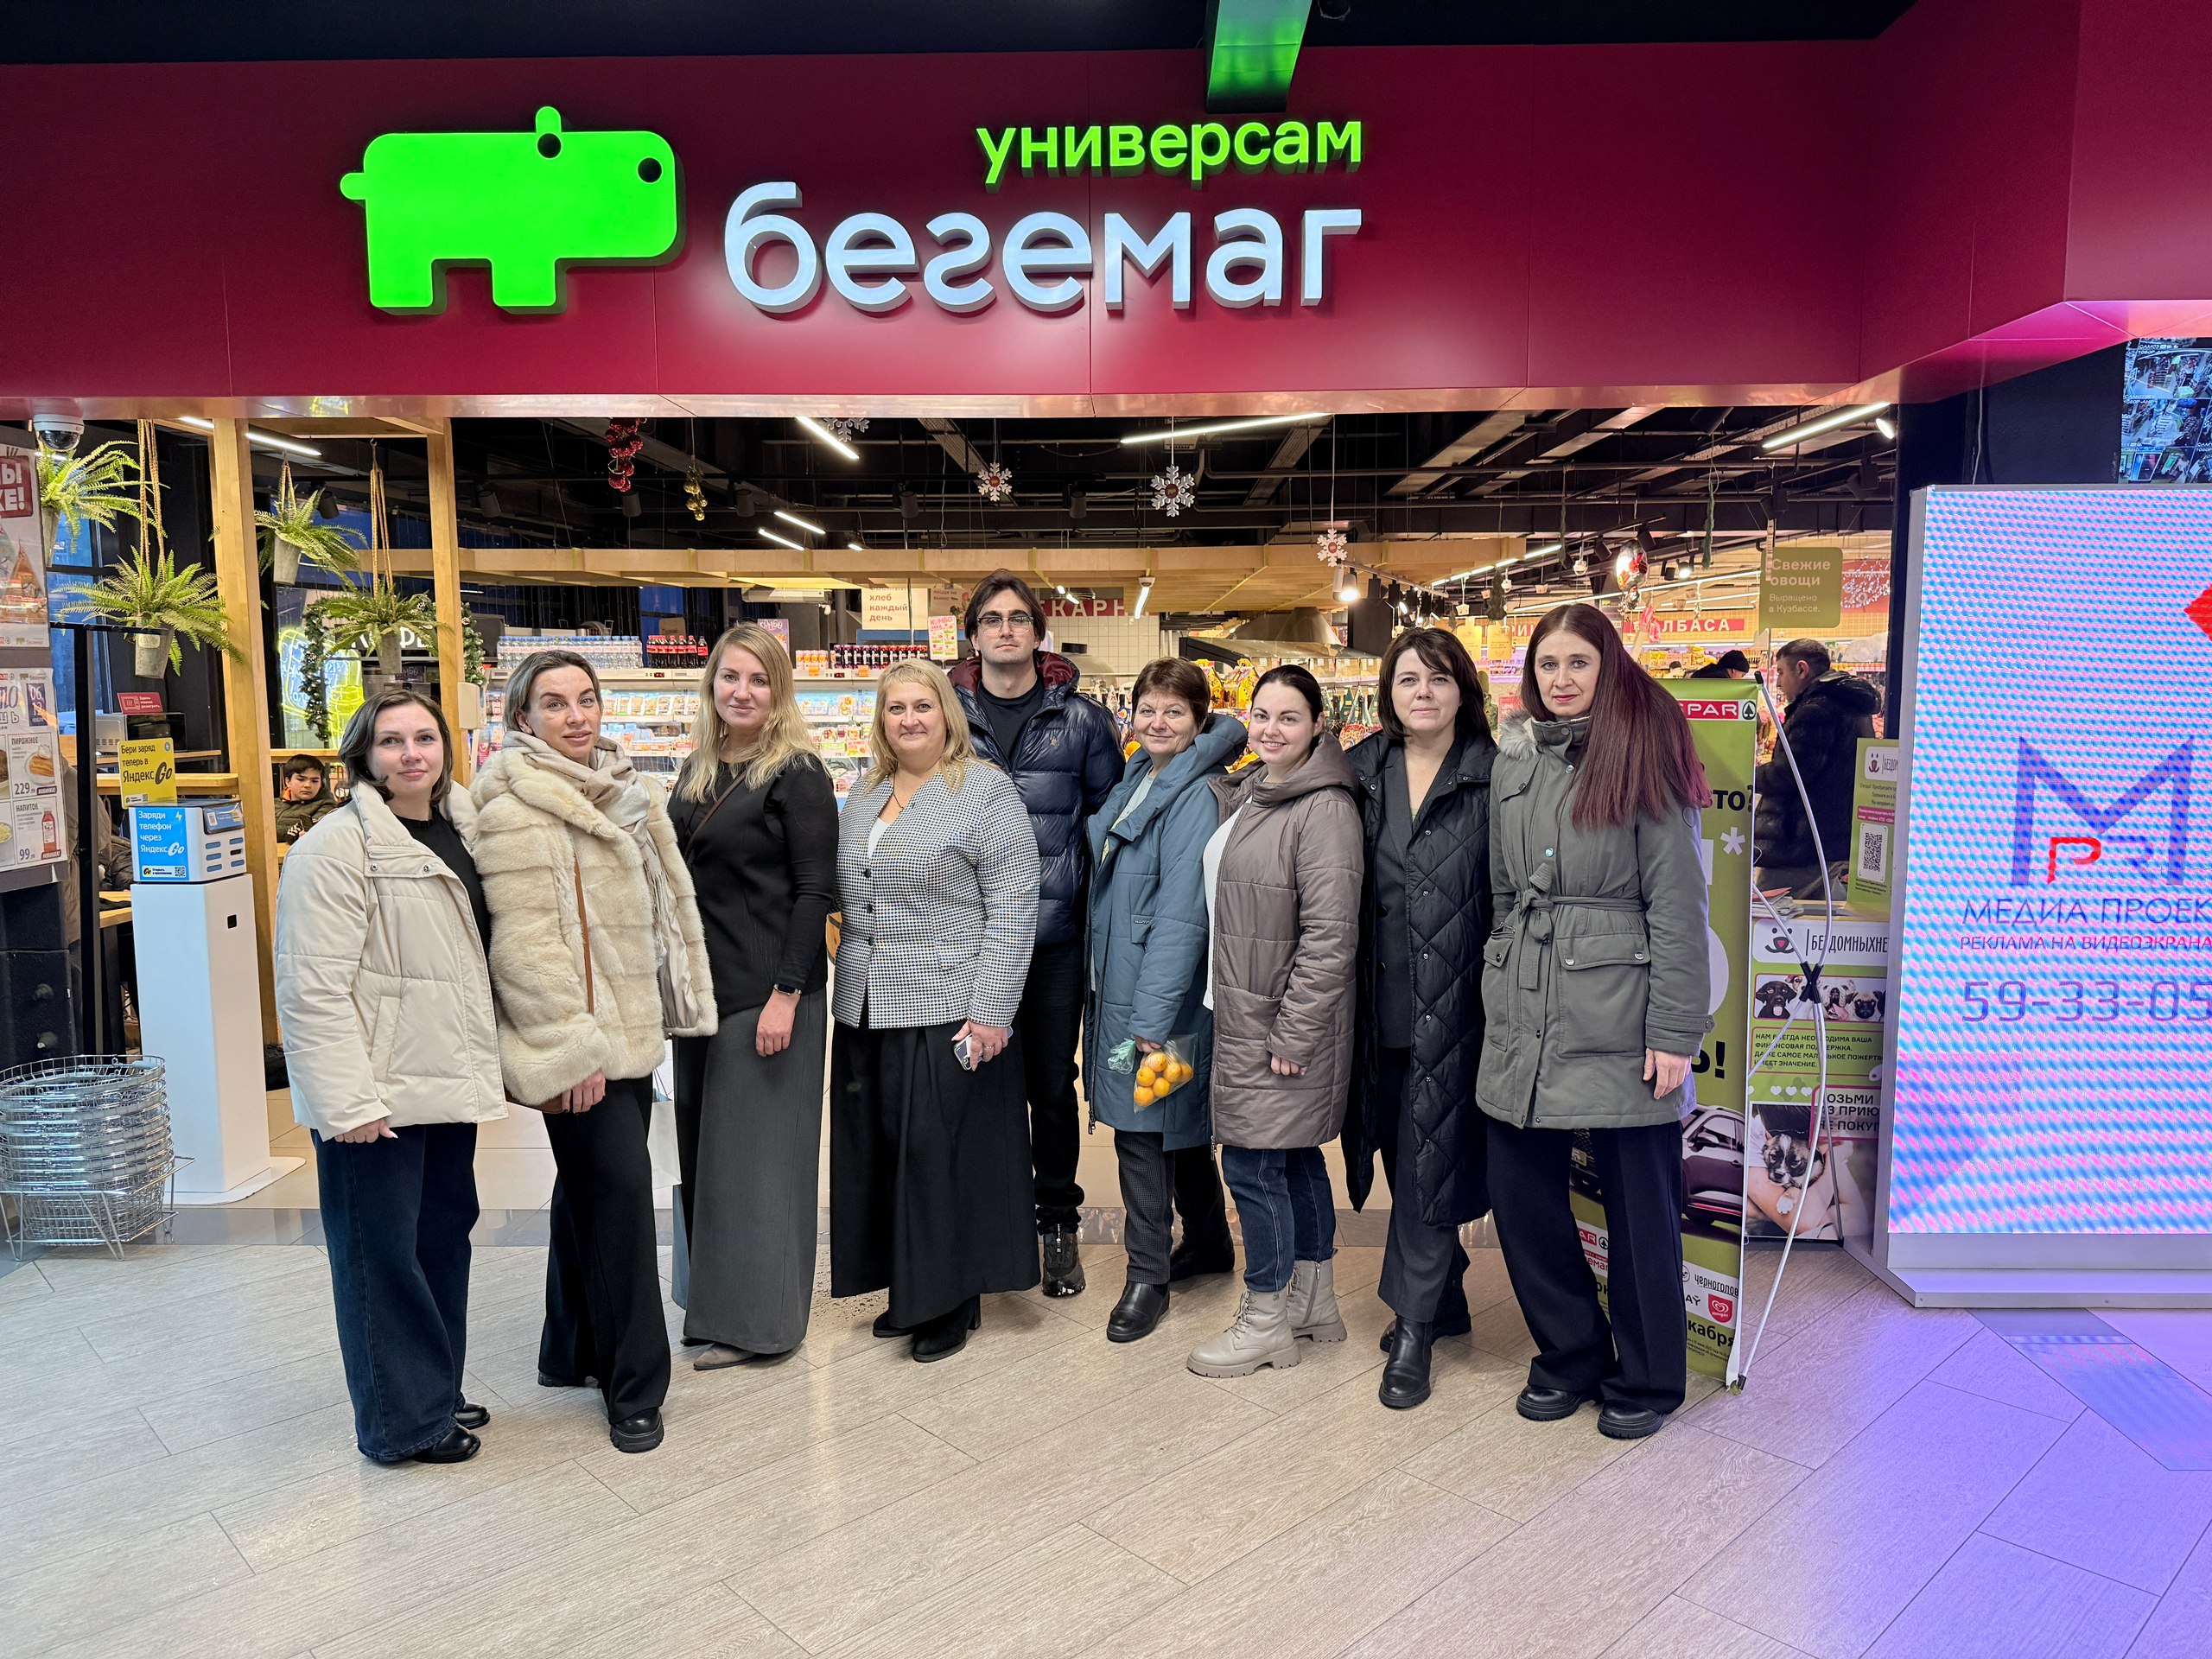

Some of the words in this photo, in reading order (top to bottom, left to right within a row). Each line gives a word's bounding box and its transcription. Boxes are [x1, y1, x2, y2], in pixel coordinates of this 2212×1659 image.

[976, 118, 1363, 192] универсам
[724, 180, 1363, 315] бегемаг
[1770, 558, 1831, 570] Свежие
[1770, 575, 1820, 588] овощи
[869, 593, 892, 601] хлеб
[1769, 593, 1817, 603] Выращено
[869, 603, 908, 613] каждый
[1777, 604, 1821, 614] Кузбассе.
[1633, 619, 1730, 633] ЛБАСА
[11, 736, 39, 746] ПИРОЖНОЕ
[121, 745, 137, 755] Бери
[137, 744, 156, 753] заряд
[122, 758, 143, 767] теперь
[123, 770, 155, 784] Яндекс
[155, 761, 173, 785] Go
[16, 803, 39, 812] НАПИТОК
[138, 810, 166, 820] Заряди
[139, 823, 172, 831] телефон
[140, 834, 162, 842] через
[140, 845, 168, 854] Яндекс
[167, 842, 185, 856] Go
[1962, 898, 2088, 927] МЕДИА
[1811, 935, 1890, 954] БЕДОМНЫХНЕ
[1960, 936, 2046, 950] РЕКЛАМА
[2052, 936, 2077, 950] НА
[1827, 1093, 1874, 1104] ОЗЬМИ
